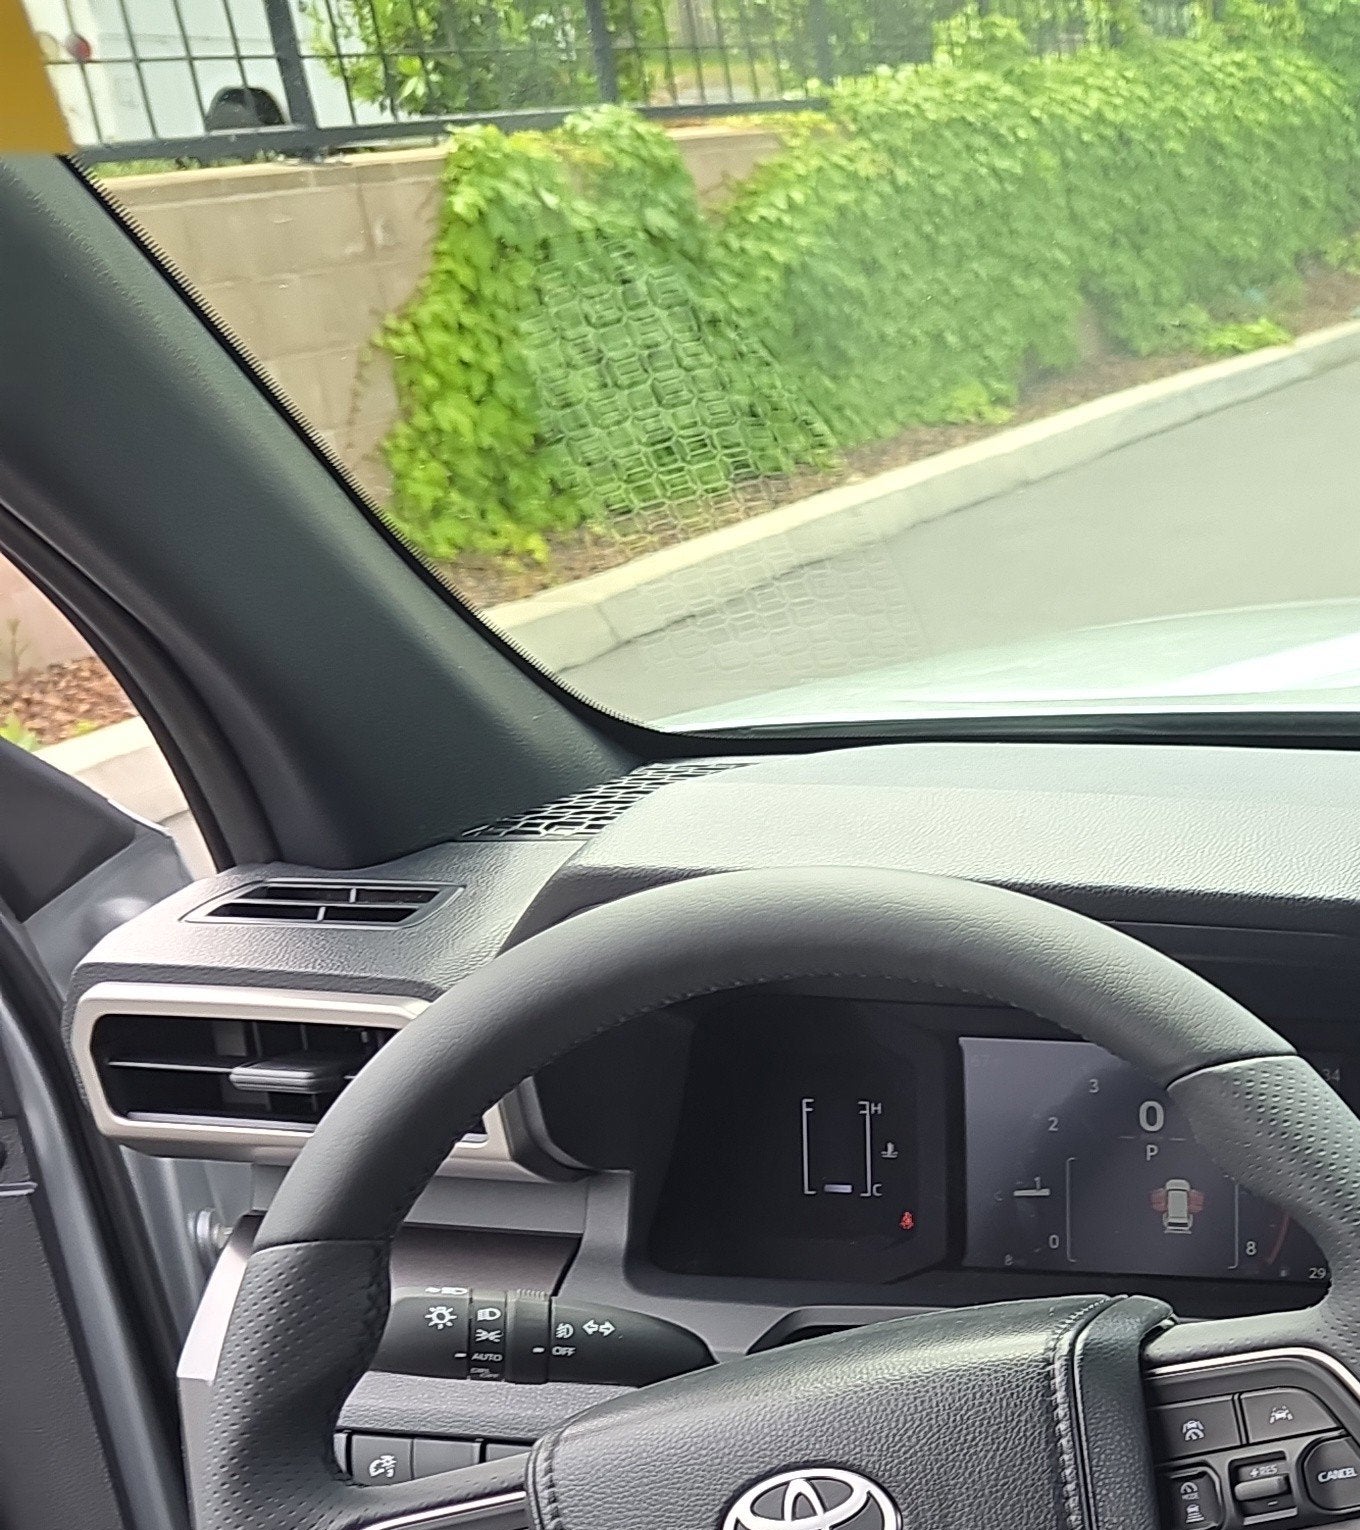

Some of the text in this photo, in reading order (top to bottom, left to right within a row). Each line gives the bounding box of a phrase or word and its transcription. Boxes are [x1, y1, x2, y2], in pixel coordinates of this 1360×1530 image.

[1089, 1079, 1099, 1093] 3
[871, 1102, 882, 1115] H
[1139, 1100, 1165, 1132] 0
[1048, 1116, 1059, 1132] 2
[1145, 1144, 1159, 1161] P
[1049, 1234, 1059, 1249] 0
[1246, 1240, 1257, 1256] 8
[1309, 1267, 1327, 1279] 29
[471, 1353, 503, 1362] AUTO
[552, 1346, 576, 1356] OFF
[1317, 1467, 1358, 1483] CANCEL
